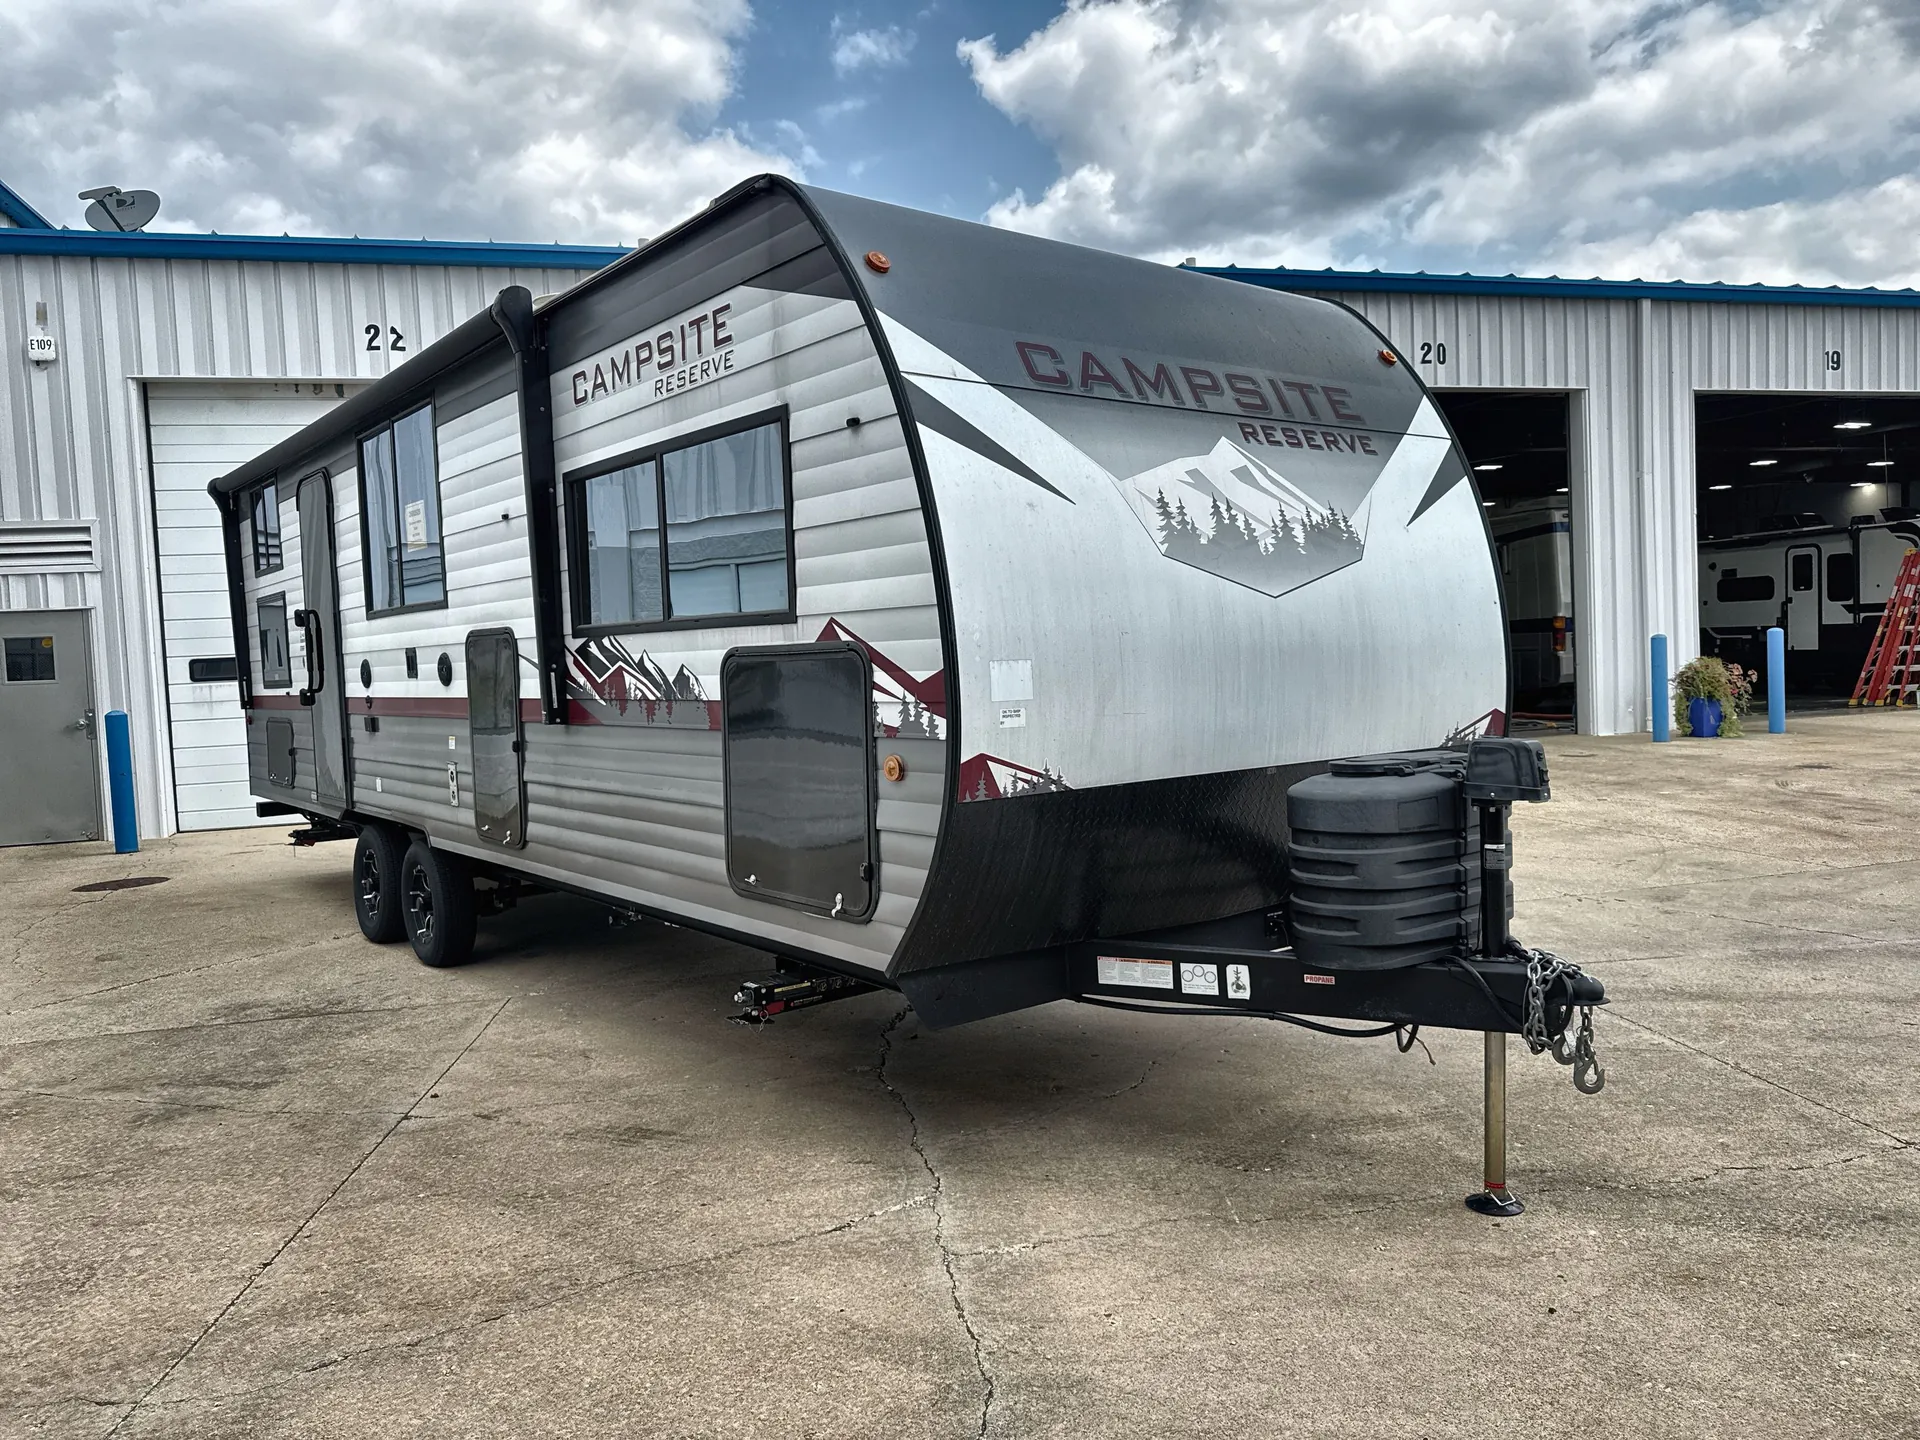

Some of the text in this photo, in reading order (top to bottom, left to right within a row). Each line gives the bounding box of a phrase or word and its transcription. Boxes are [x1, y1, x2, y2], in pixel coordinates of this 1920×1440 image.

[30, 339, 51, 350] E109
[365, 324, 406, 351] 22
[572, 303, 734, 405] CAMPSITE
[1420, 342, 1446, 365] 20
[1825, 351, 1840, 370] 19
[654, 350, 734, 397] RESERVE
[1016, 341, 1364, 422] CAMPSITE
[1237, 422, 1379, 455] RESERVE
[1305, 975, 1334, 984] PROPANE
